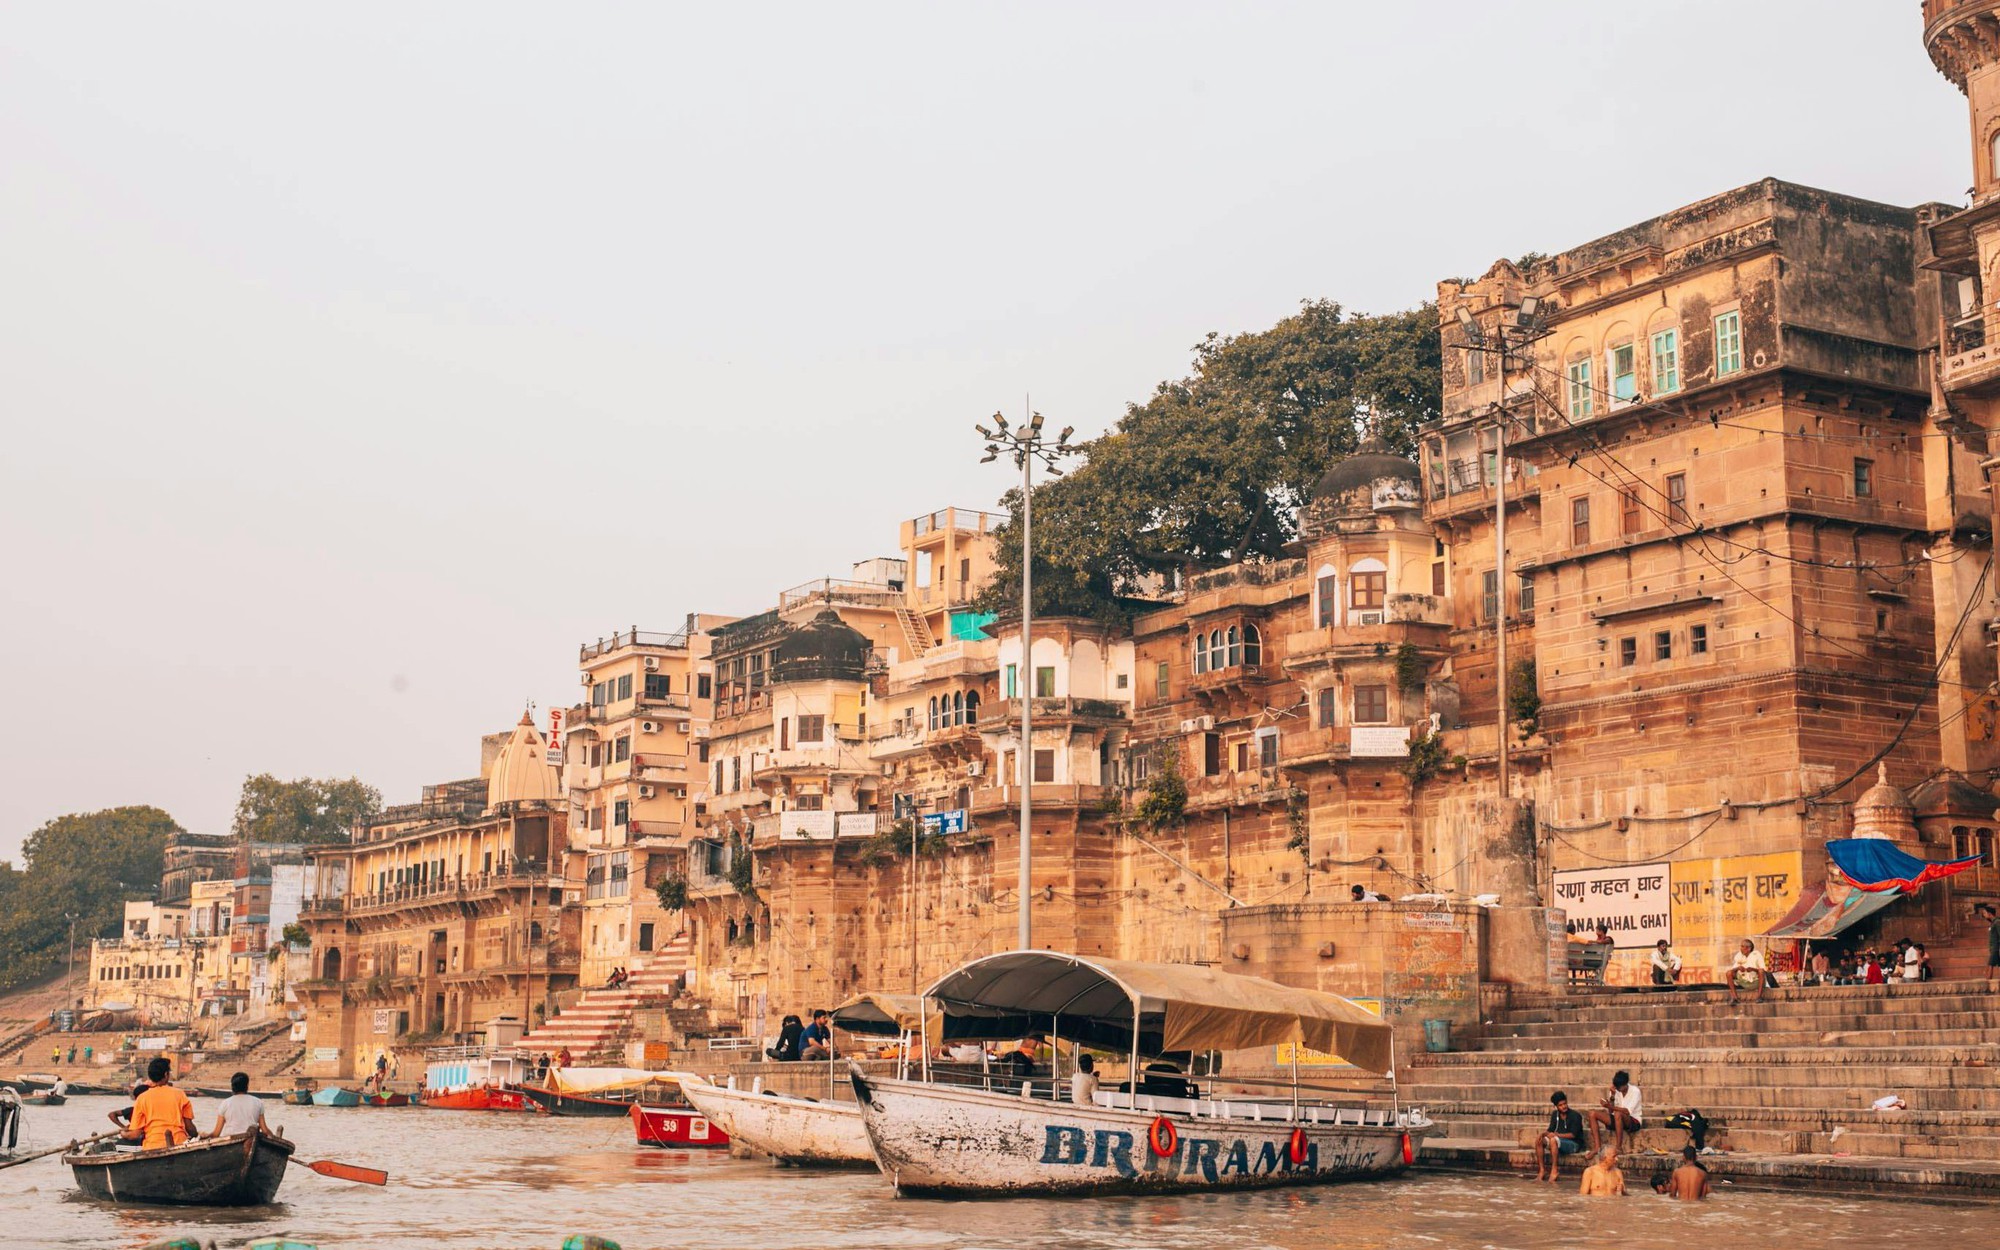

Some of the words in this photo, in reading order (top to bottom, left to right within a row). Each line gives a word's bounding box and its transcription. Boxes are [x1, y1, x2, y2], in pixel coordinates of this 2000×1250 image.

[549, 710, 562, 749] SITA
[1556, 881, 1586, 898] राणा
[1590, 878, 1631, 896] महल
[1637, 875, 1664, 891] घाट
[1755, 873, 1789, 899] घाट
[1640, 913, 1668, 929] GHAT
[663, 1120, 677, 1133] 39
[1332, 1151, 1379, 1170] PALACE
